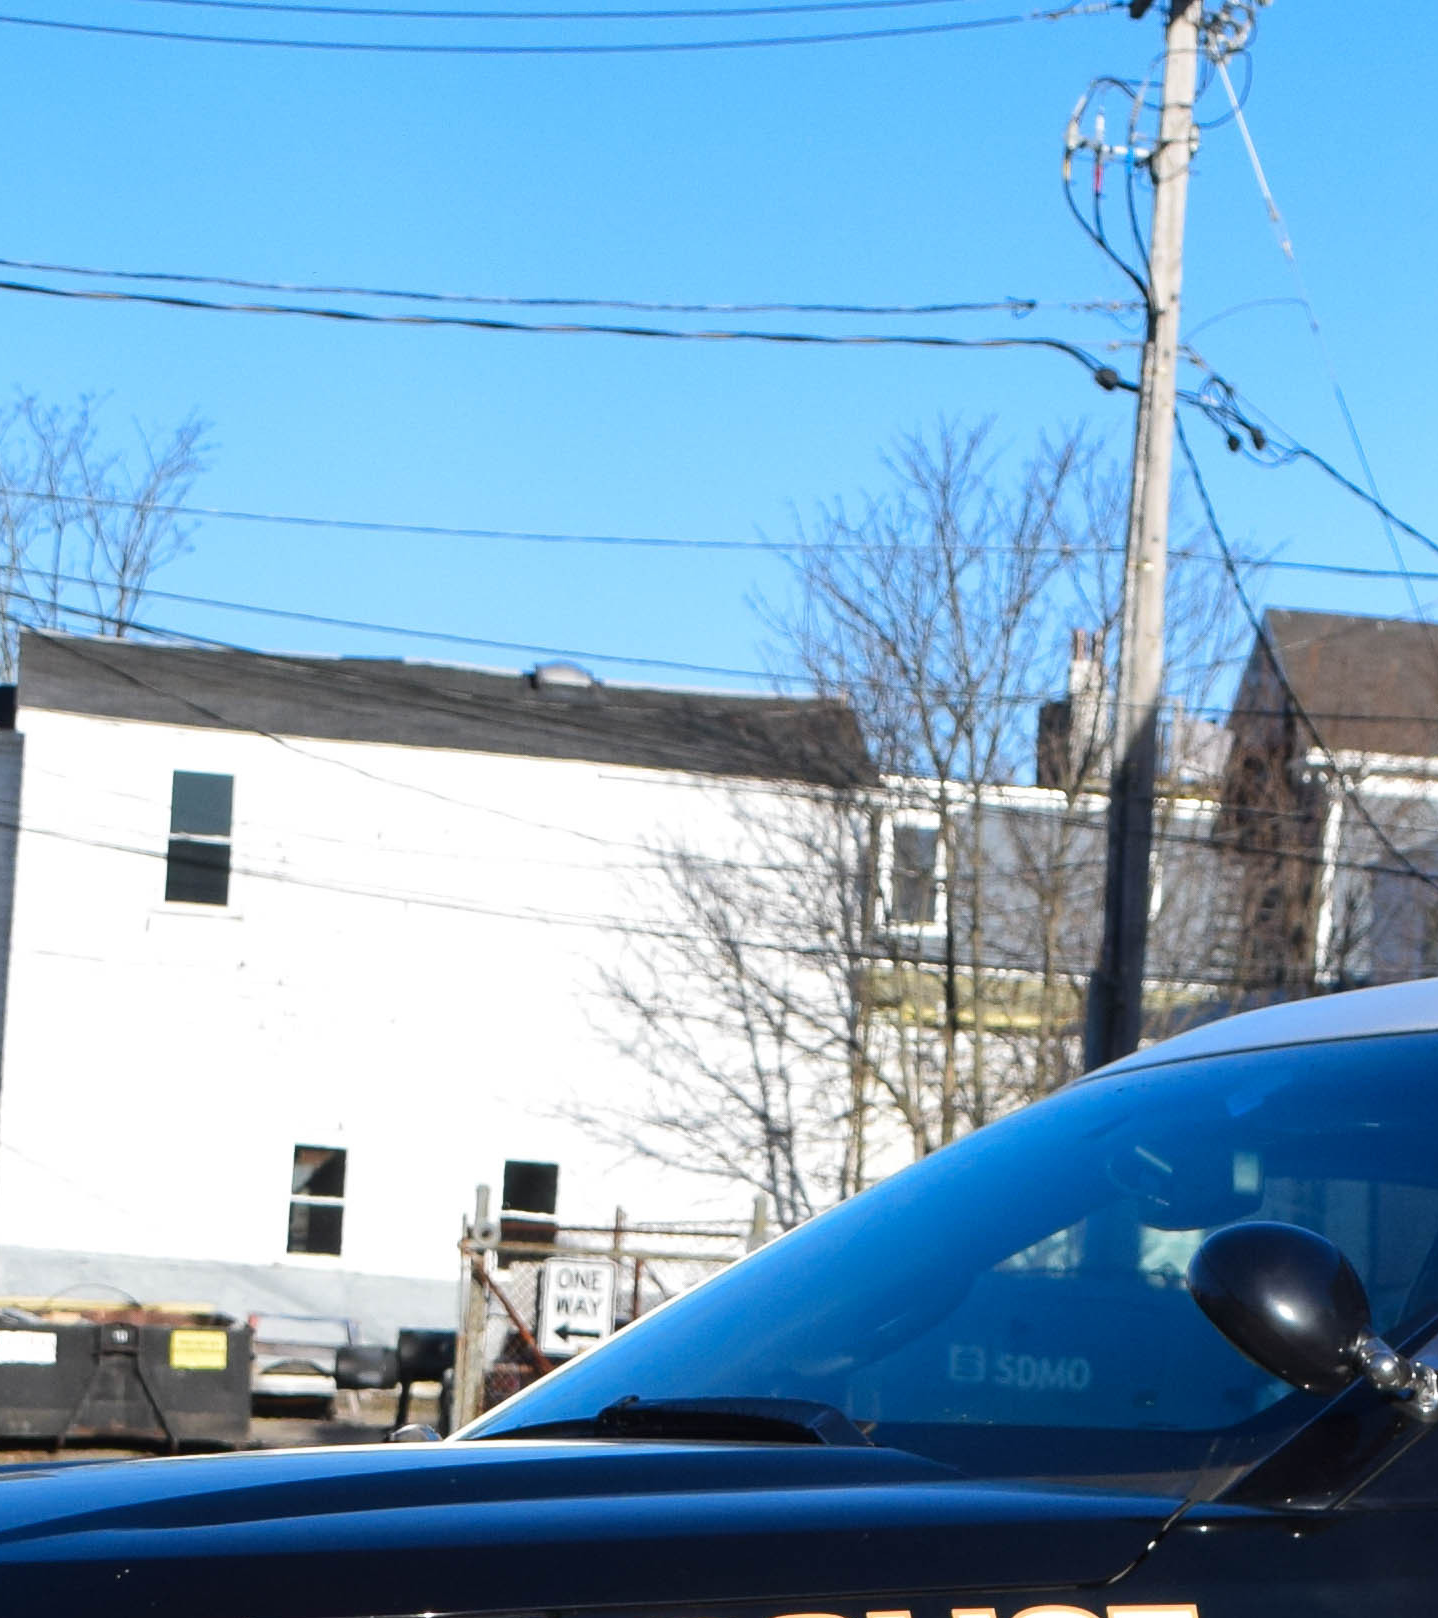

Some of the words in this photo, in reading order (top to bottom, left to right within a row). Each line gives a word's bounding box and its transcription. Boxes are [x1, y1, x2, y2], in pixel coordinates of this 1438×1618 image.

[558, 1267, 603, 1290] ONE
[556, 1296, 603, 1317] WAY
[995, 1354, 1091, 1390] SDMO
